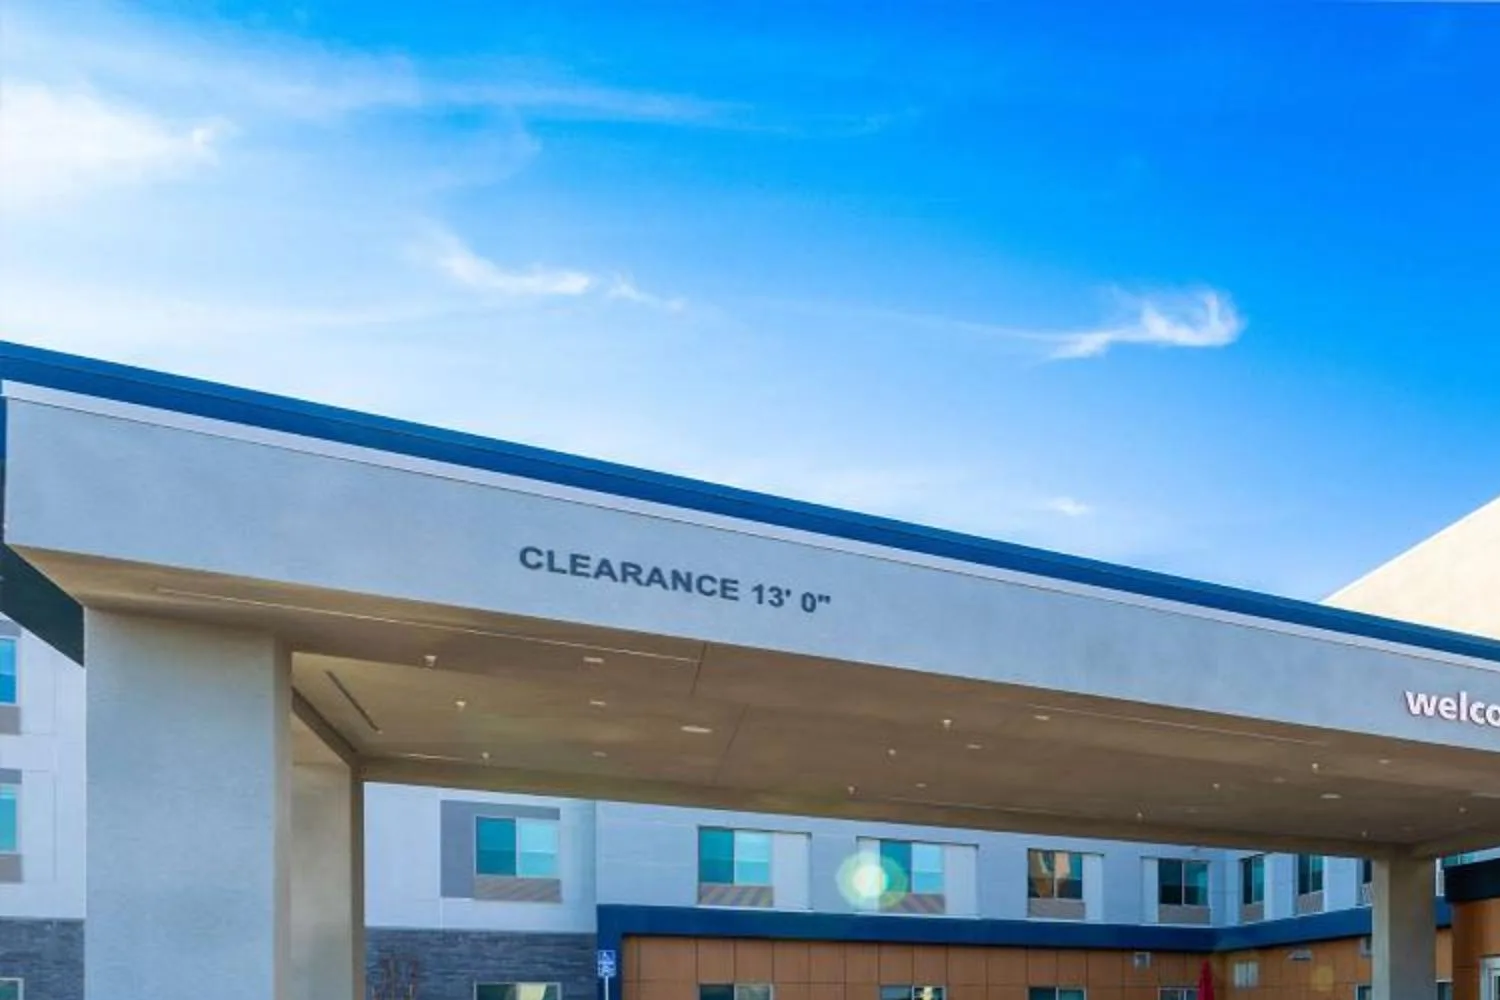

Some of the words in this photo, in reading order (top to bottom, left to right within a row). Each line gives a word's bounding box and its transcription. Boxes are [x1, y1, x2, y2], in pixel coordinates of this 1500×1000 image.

[519, 546, 739, 600] CLEARANCE
[751, 584, 791, 607] 13'
[801, 592, 830, 613] 0"
